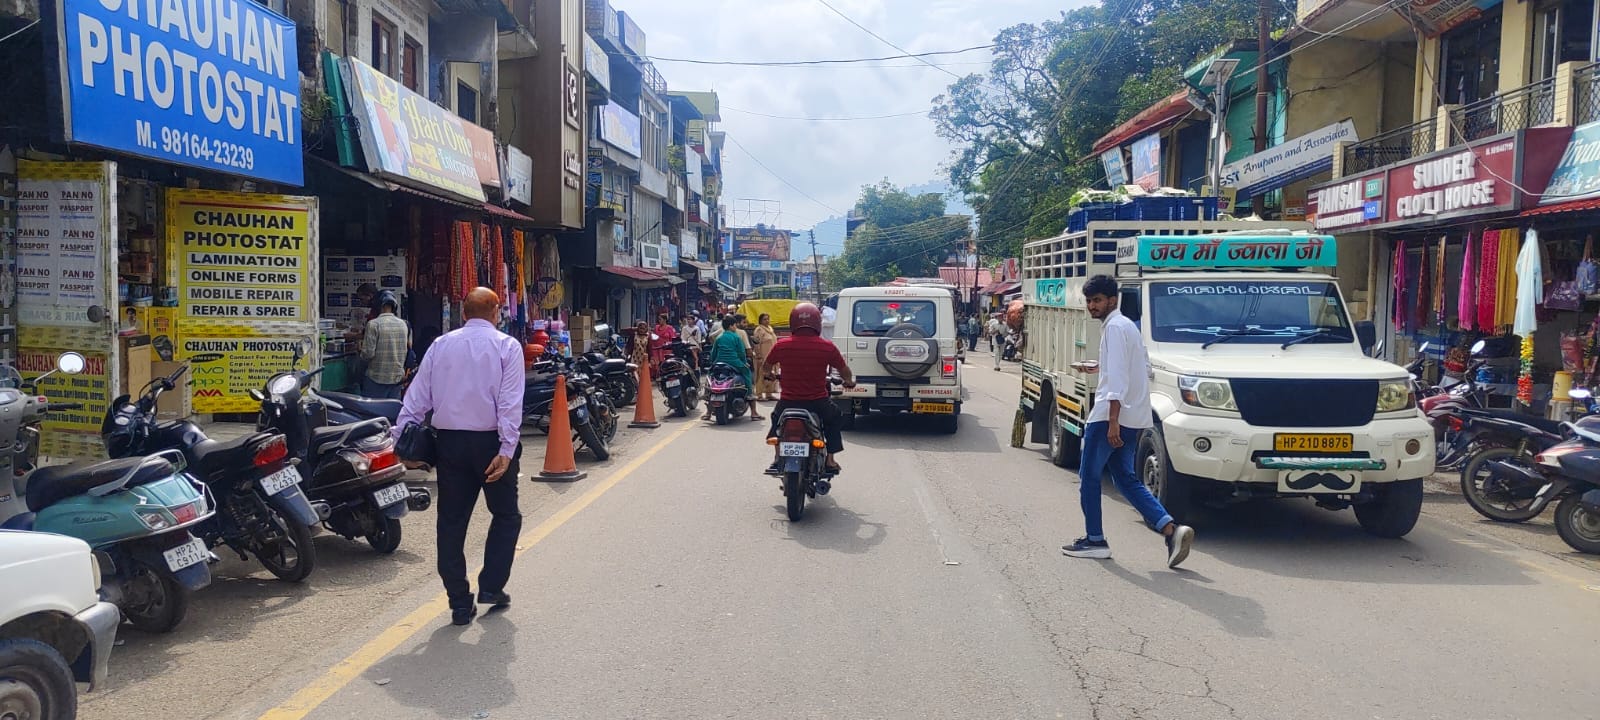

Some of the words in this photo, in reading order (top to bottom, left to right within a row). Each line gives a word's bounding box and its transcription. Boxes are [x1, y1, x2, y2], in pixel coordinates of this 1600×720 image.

[103, 0, 285, 80] AUHAN
[78, 12, 297, 144] PHOTOSTAT
[136, 119, 157, 149] M.
[161, 126, 254, 170] 98164-23239
[1244, 153, 1283, 175] Anupam
[1285, 139, 1302, 159] and
[1304, 127, 1349, 152] Associates
[1413, 151, 1475, 190] SUNDER
[1444, 179, 1495, 211] HOUSE
[194, 211, 294, 230] CHAUHAN
[184, 231, 303, 250] PHOTOSTAT
[1151, 243, 1187, 261] जय
[1193, 238, 1224, 260] माँ
[1228, 242, 1291, 260] ज्वाला
[1295, 237, 1324, 260] जी
[191, 254, 297, 267] LAMINATION
[191, 271, 245, 282] ONLINE
[250, 273, 297, 283] FORMS
[191, 289, 243, 299] MOBILE
[247, 290, 294, 301] REPAIR
[192, 306, 238, 316] REPAIR
[242, 307, 251, 316] &
[256, 307, 295, 317] SPARE
[184, 341, 238, 351] CHAUHAN
[243, 342, 298, 351] PHOTOSTA
[191, 379, 224, 387] ppo
[1284, 438, 1296, 448] HP
[1299, 438, 1319, 448] 21D
[1322, 438, 1348, 448] 8876
[176, 543, 198, 557] HP21
